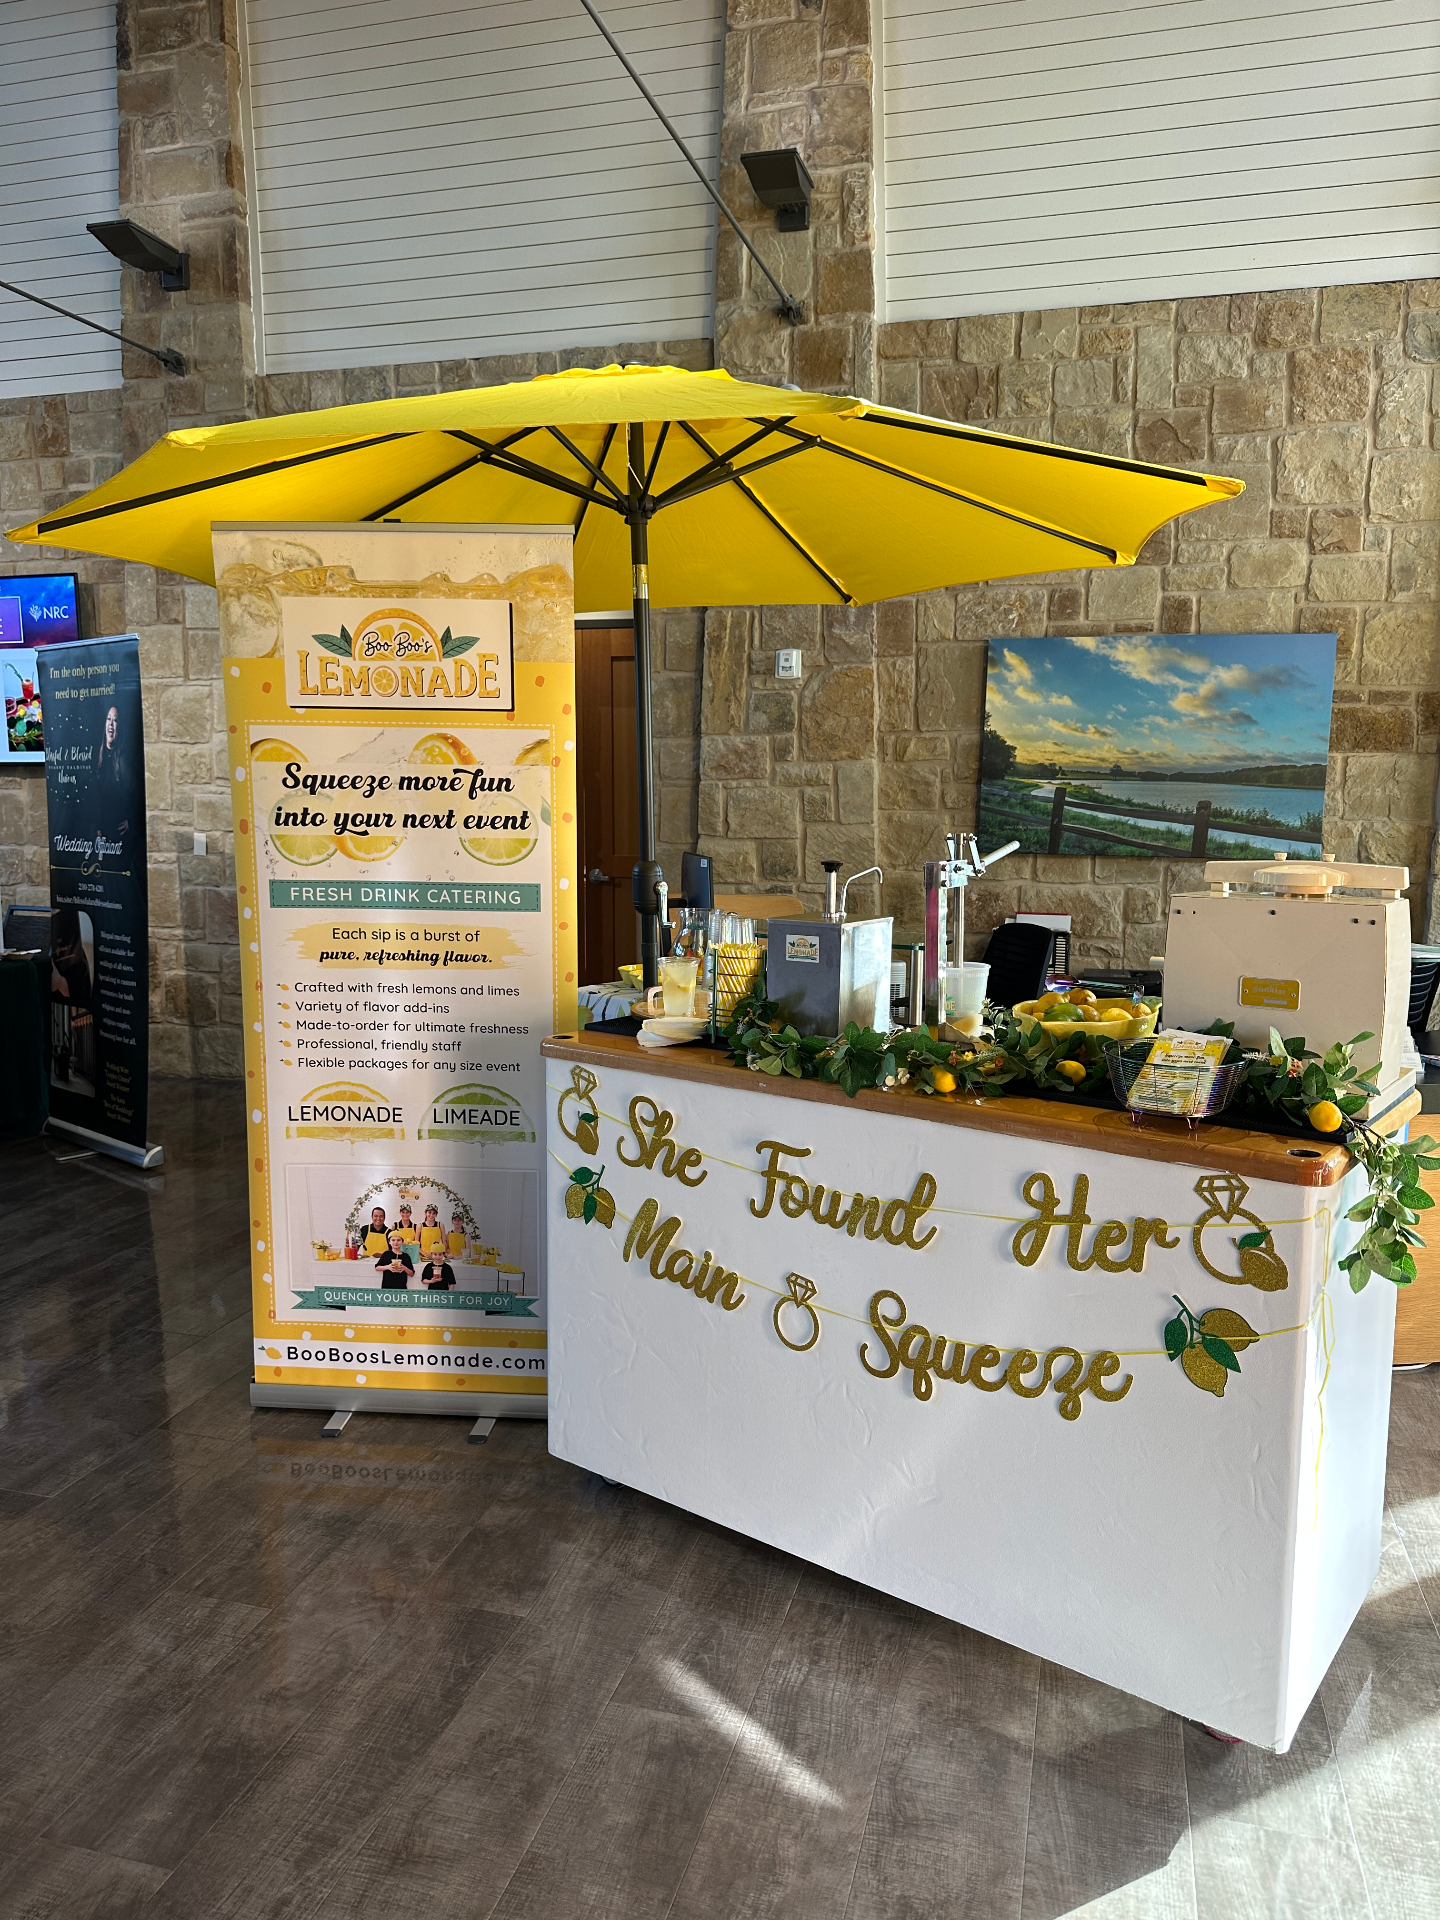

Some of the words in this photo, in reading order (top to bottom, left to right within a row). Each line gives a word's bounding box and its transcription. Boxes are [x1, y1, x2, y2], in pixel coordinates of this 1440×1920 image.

[43, 606, 69, 619] NRC
[363, 631, 392, 657] Boo
[393, 631, 433, 658] Boo's
[50, 667, 60, 678] I'm
[61, 666, 70, 678] the
[72, 664, 86, 679] only
[87, 664, 107, 678] person
[109, 663, 120, 676] you
[297, 650, 501, 699] LEMONADE
[55, 687, 69, 700] need
[71, 688, 78, 698] to
[79, 688, 89, 701] get
[90, 683, 116, 697] married!
[282, 762, 392, 798] Squeeze
[399, 771, 464, 792] more
[454, 768, 515, 800] fun
[274, 806, 328, 828] into
[334, 811, 397, 836] your
[402, 808, 457, 831] next
[463, 811, 531, 831] event
[54, 835, 94, 859] Wedding
[290, 887, 352, 902] FRESH
[360, 888, 420, 904] DRINK
[427, 889, 522, 905] CATERING
[332, 928, 367, 940] Each
[371, 928, 391, 945] sip
[395, 928, 406, 941] is
[410, 932, 420, 941] a
[424, 929, 460, 942] burst
[464, 930, 481, 943] of
[319, 951, 360, 964] pure,
[362, 949, 441, 967] refreshing
[442, 950, 493, 967] flavor.
[294, 982, 343, 993] Crafted
[347, 982, 373, 994] with
[377, 982, 408, 994] fresh
[412, 983, 457, 995] lemons
[460, 984, 484, 996] and
[487, 985, 520, 997] limes
[295, 1001, 342, 1015] Variety
[346, 1002, 360, 1012] of
[362, 1002, 400, 1013] flavor
[403, 1002, 450, 1014] add-ins
[296, 1020, 389, 1032] Made-to-order
[393, 1020, 410, 1032] for
[415, 1021, 466, 1033] ultimate
[469, 1022, 529, 1034] freshness
[297, 1038, 377, 1052] Professional,
[380, 1040, 428, 1054] friendly
[432, 1040, 462, 1052] staff
[298, 1057, 345, 1069] Flexible
[349, 1058, 408, 1072] packages
[411, 1058, 430, 1070] for
[433, 1061, 456, 1073] any
[460, 1060, 482, 1071] size
[486, 1060, 521, 1072] event
[288, 1105, 404, 1124] LEMONADE
[433, 1108, 521, 1127] LIMEADE
[616, 1095, 708, 1187] She
[750, 1140, 938, 1250] Found
[1012, 1172, 1180, 1274] Her
[324, 1290, 373, 1303] QUENCH
[376, 1292, 408, 1303] YOUR
[413, 1293, 454, 1305] THIRST
[459, 1295, 482, 1305] FOR
[487, 1296, 510, 1306] JOY
[622, 1197, 746, 1312] Main
[859, 1289, 1134, 1422] Squeeze
[287, 1346, 546, 1371] BooBoosLemonade.com
